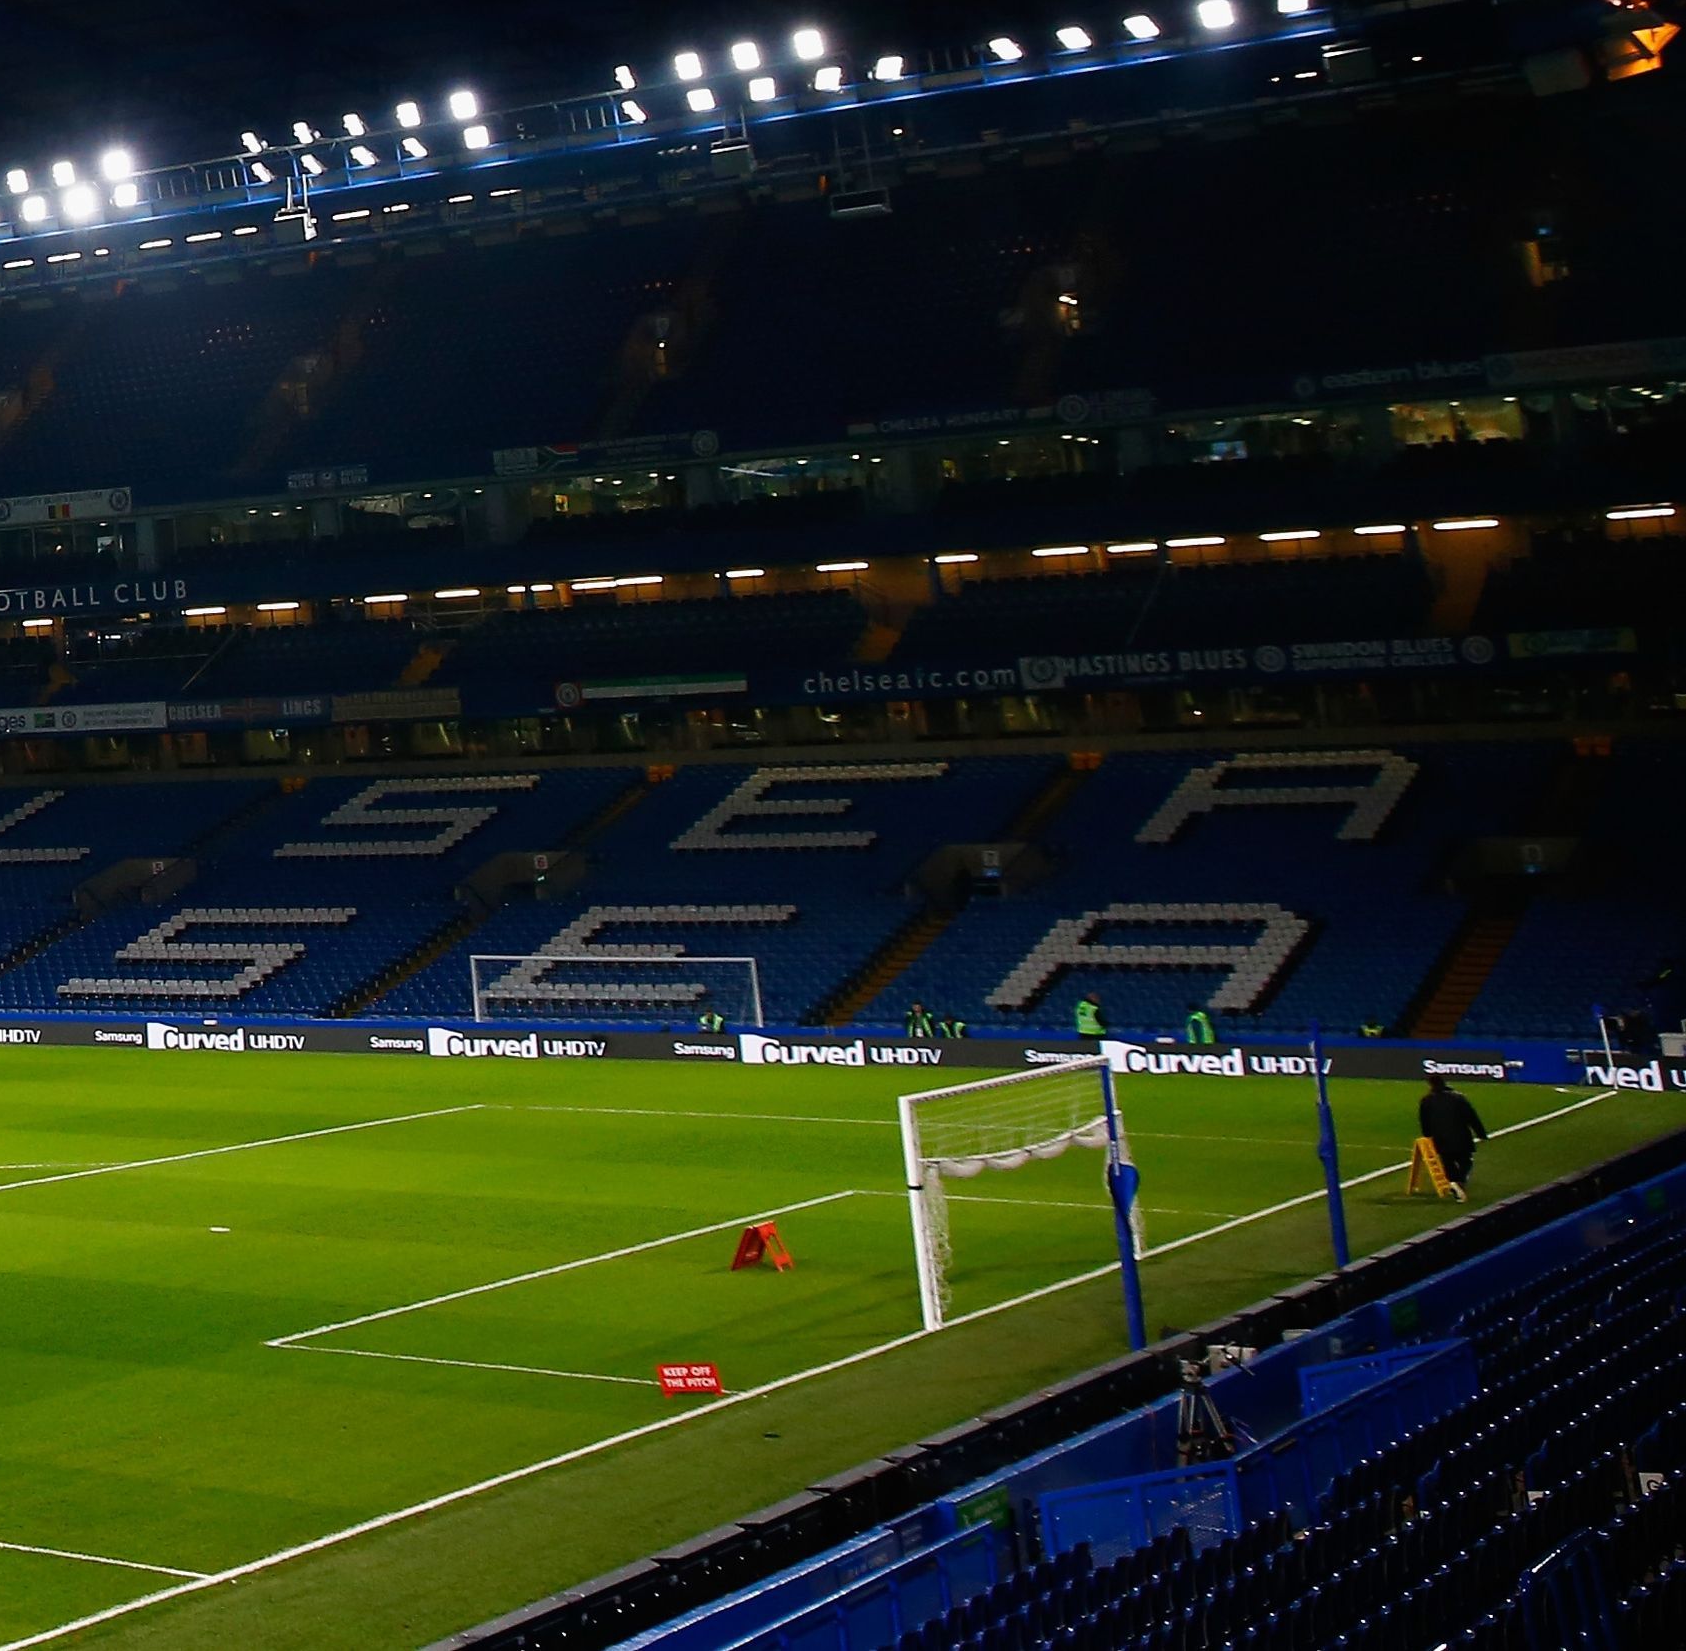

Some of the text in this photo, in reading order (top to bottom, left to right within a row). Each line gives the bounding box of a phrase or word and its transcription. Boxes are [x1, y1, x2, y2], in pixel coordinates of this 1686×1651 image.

[113, 577, 189, 604] CLUB
[1060, 648, 1248, 676] HASTINGS BLUES
[803, 667, 1017, 693] chelseafc.com
[283, 699, 322, 714] LINCS
[94, 1022, 305, 1052] Samsung Curved UHDTV
[369, 1027, 606, 1058] Samsung Curved UHDTV
[672, 1034, 942, 1067] Samsung Curved UHDTV
[1099, 1040, 1245, 1077] Curved
[1422, 1059, 1504, 1079] Samsung
[1585, 1060, 1664, 1091] rved
[662, 1366, 712, 1378] KEEP OFF
[665, 1377, 717, 1388] THE PITCH
